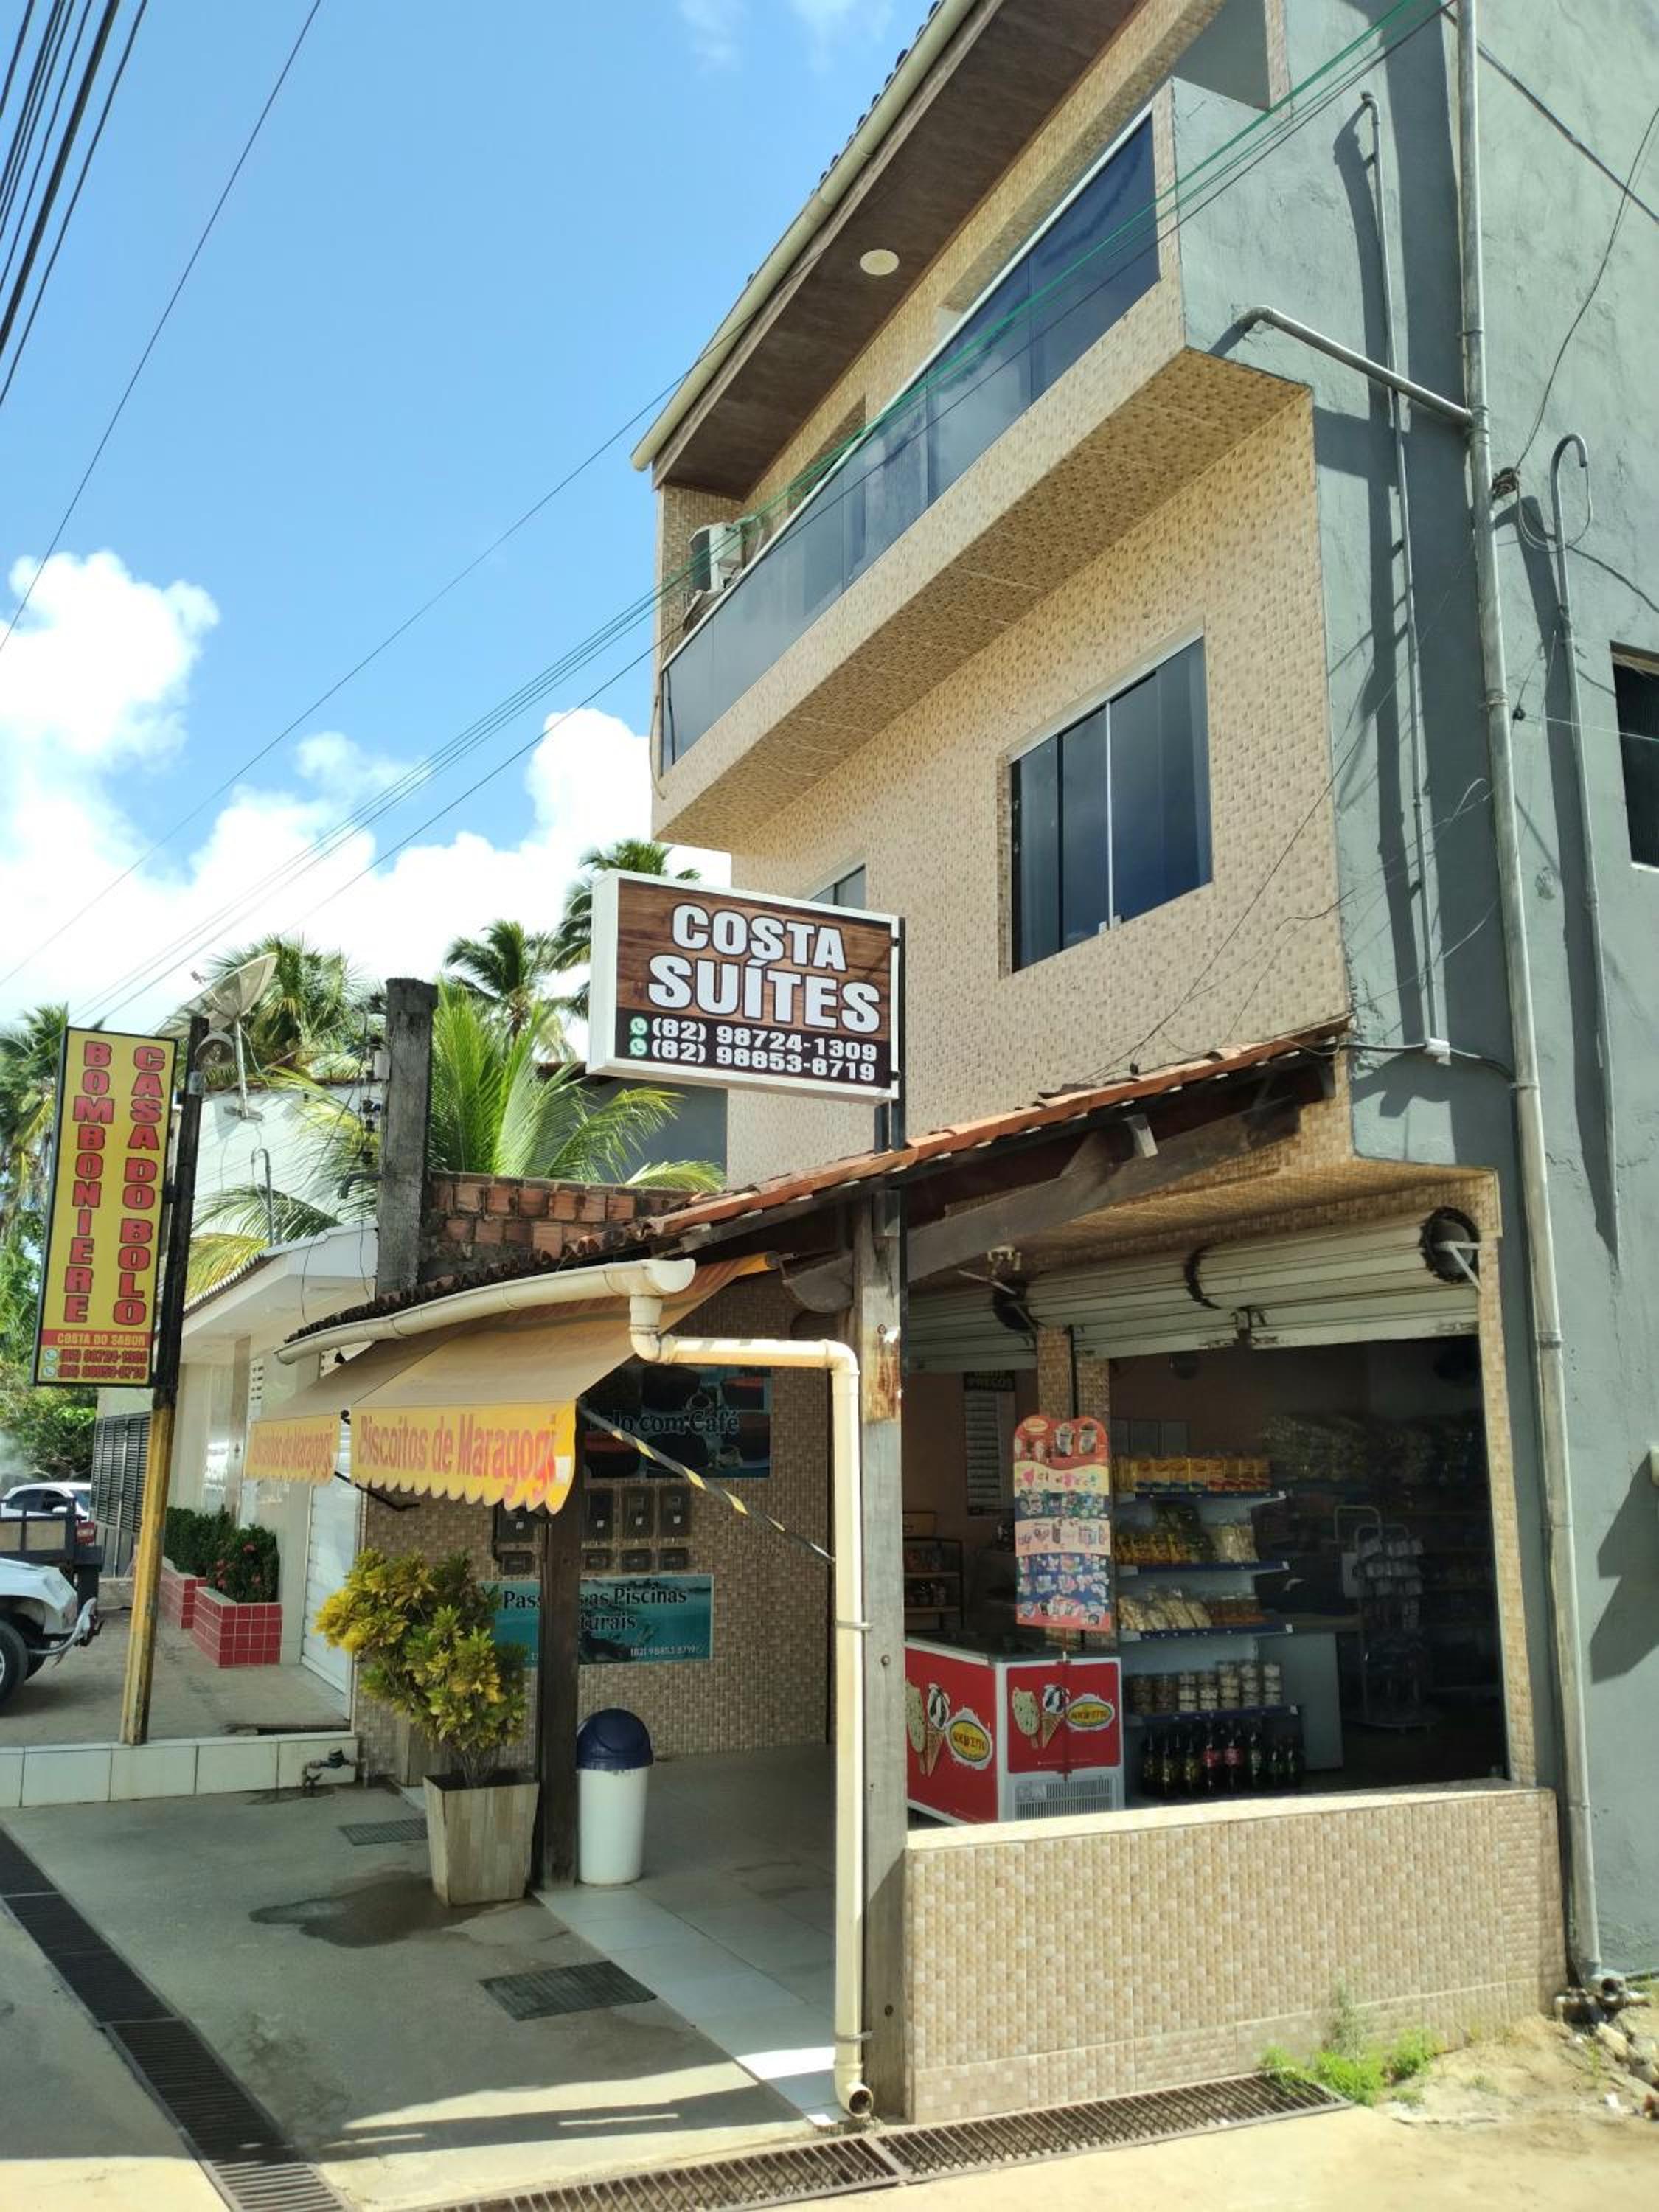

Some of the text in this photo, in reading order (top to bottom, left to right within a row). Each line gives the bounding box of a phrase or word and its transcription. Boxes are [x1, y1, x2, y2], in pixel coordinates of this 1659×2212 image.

[672, 904, 848, 972] COSTA
[648, 954, 881, 1034] SUÍTES
[651, 1038, 875, 1082] (82) 98853-8719
[652, 1018, 877, 1062] (82) 98724-1309
[63, 1040, 114, 1324] BOMBONIERE
[113, 1046, 166, 1326] CASA DO BOLO
[639, 1414, 686, 1432] com
[689, 1409, 738, 1433] Café
[358, 1413, 557, 1500] Biscoitos de Maragogi
[580, 1610, 638, 1630] turais
[613, 1586, 687, 1605] Piscinas
